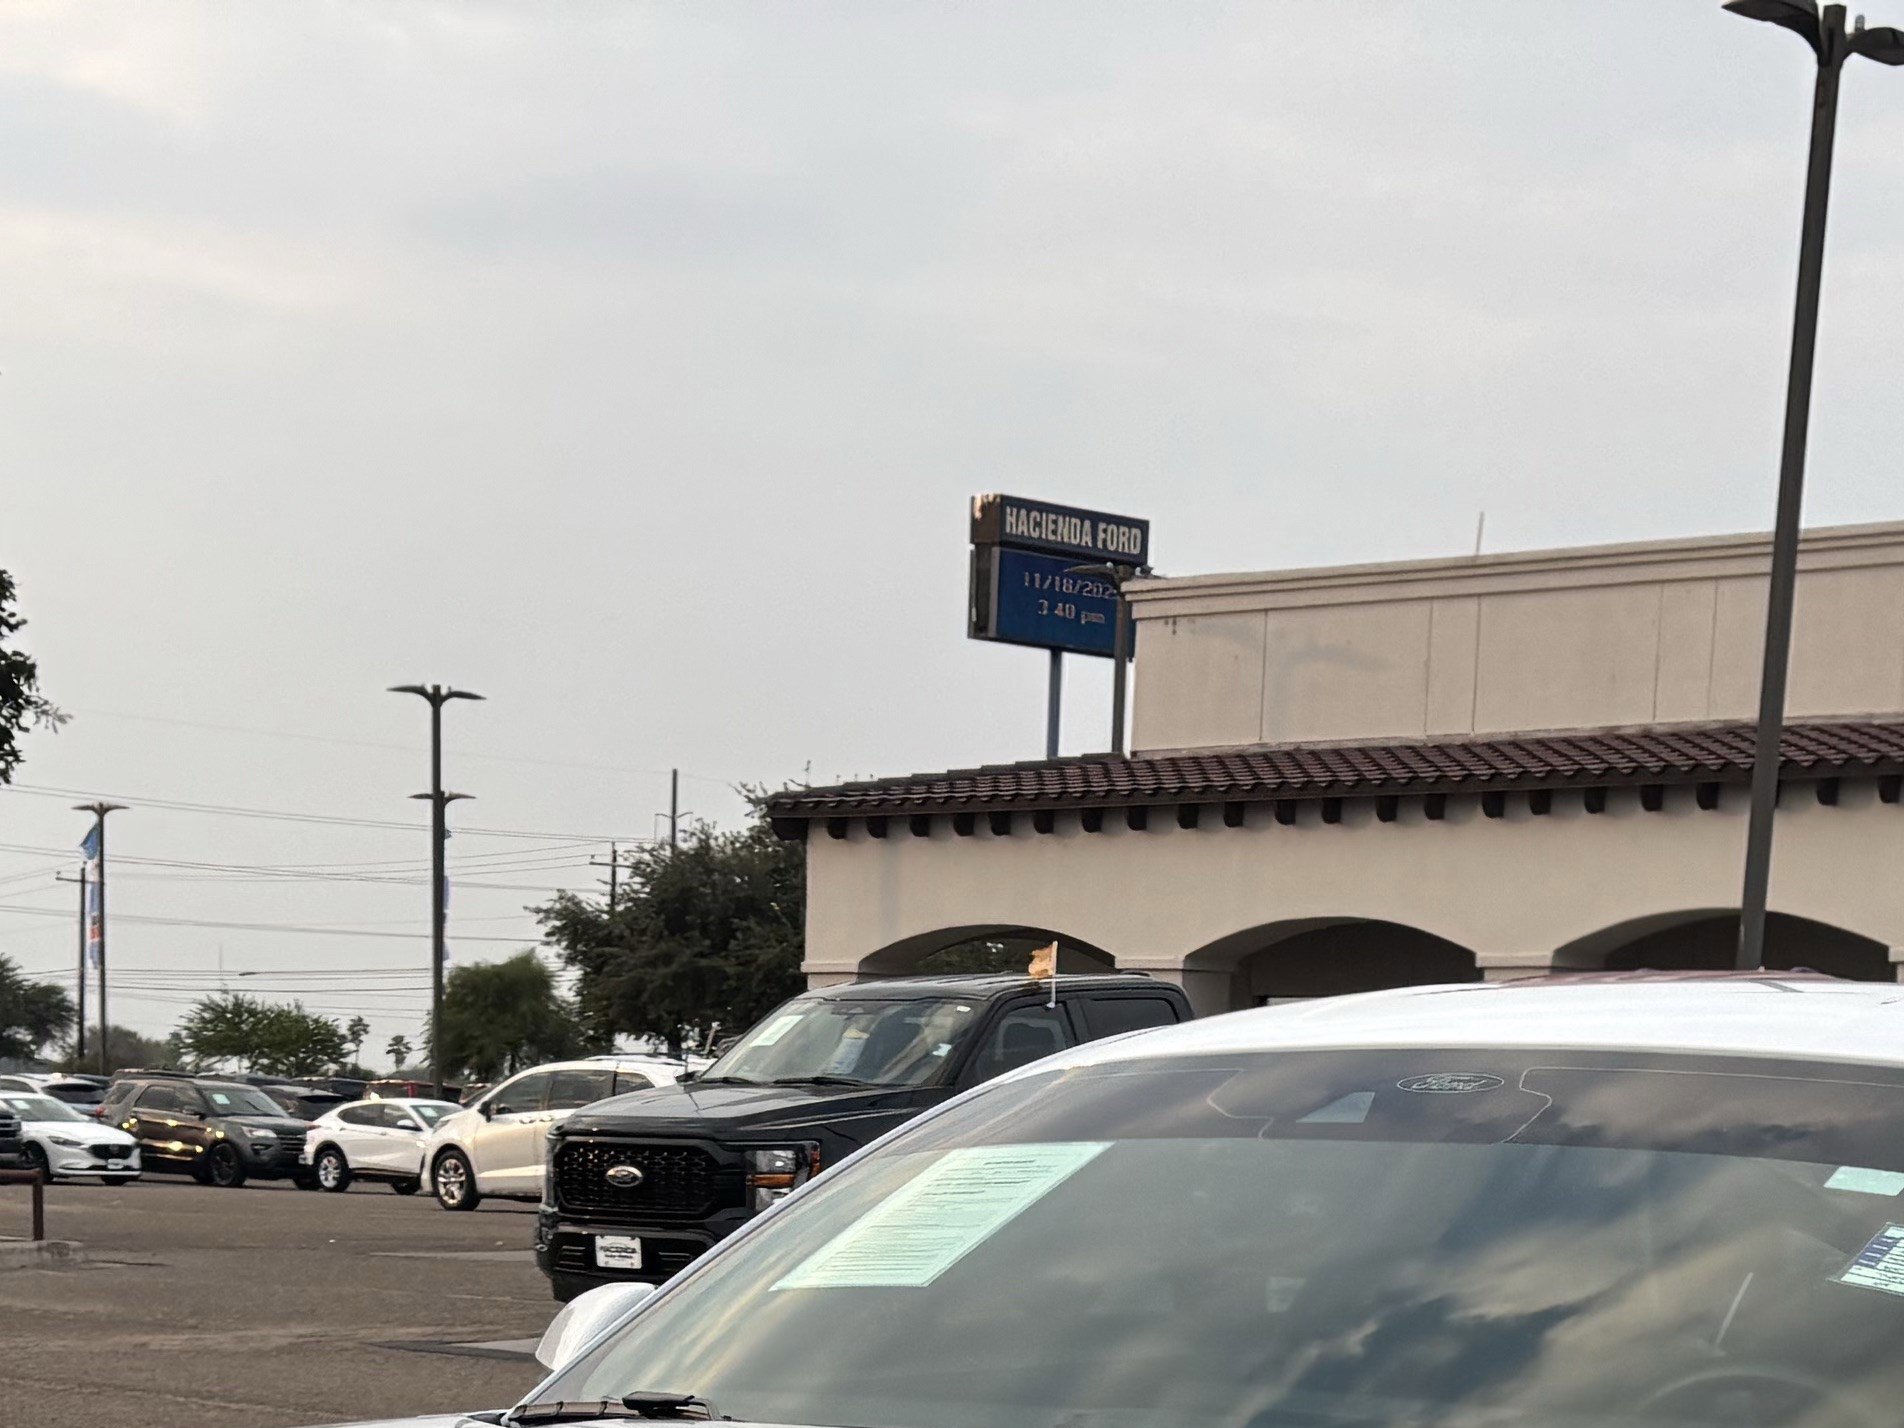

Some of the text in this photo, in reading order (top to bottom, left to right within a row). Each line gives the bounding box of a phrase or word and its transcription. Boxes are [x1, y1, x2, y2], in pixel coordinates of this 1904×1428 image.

[1004, 505, 1142, 555] HACIENDA FORD
[1024, 571, 1119, 599] 11/18/202
[1080, 610, 1106, 625] pm
